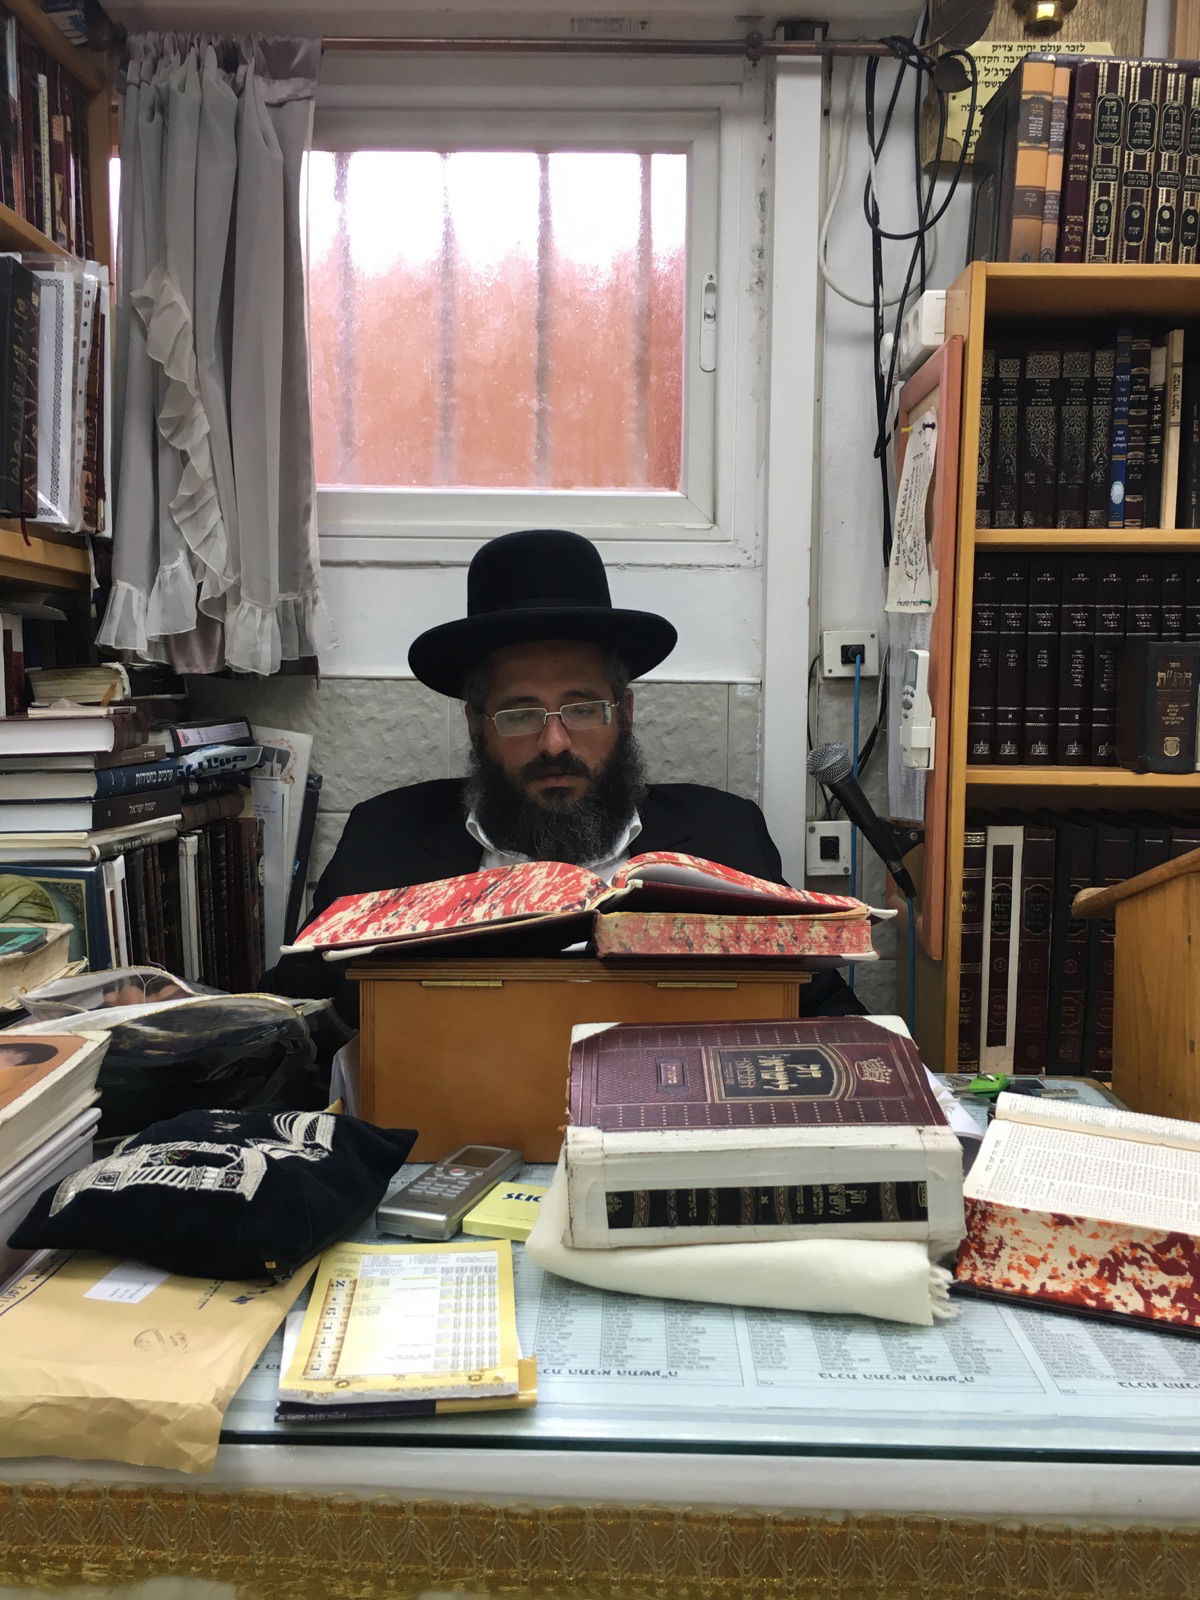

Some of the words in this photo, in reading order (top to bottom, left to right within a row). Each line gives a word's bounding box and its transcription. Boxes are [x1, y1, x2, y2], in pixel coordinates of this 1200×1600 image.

[992, 44, 1014, 53] צדיק
[1016, 44, 1036, 52] יהיה
[1040, 43, 1062, 53] עולם
[1066, 43, 1086, 52] לזכר
